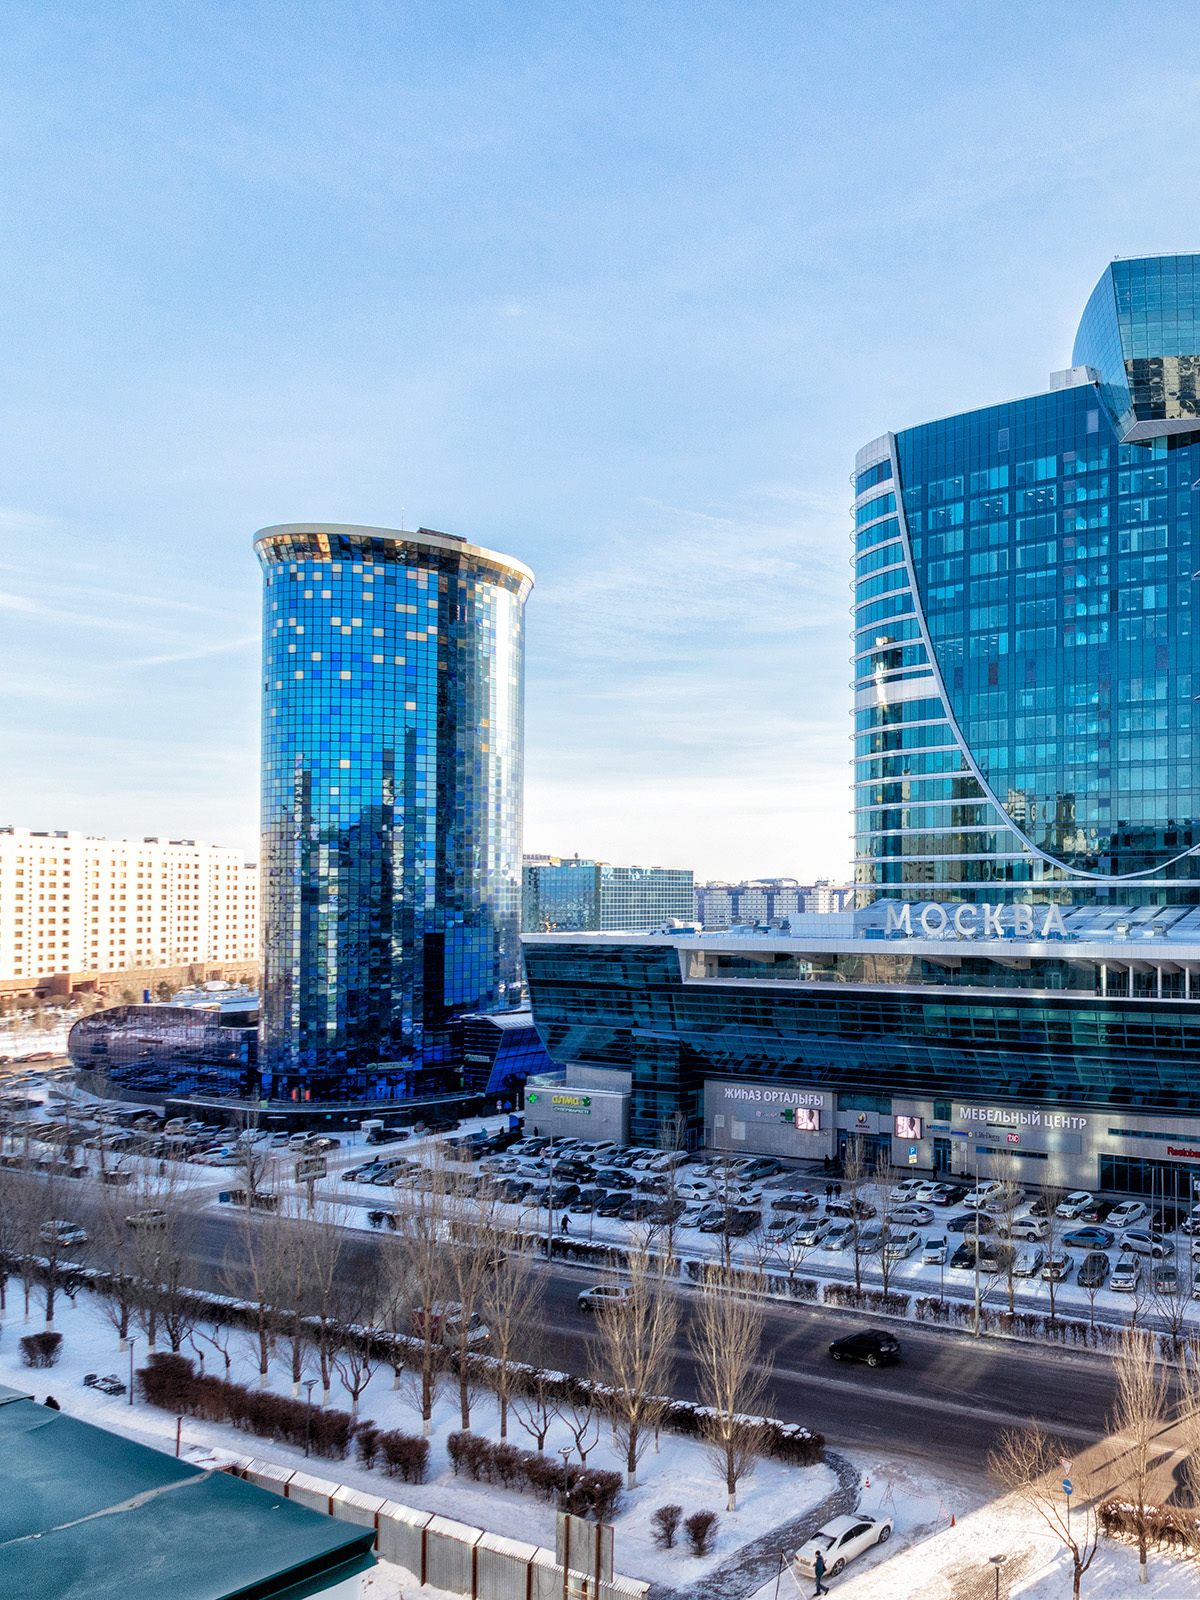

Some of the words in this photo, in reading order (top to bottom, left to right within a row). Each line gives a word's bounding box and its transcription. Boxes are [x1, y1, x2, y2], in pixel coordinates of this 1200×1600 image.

[884, 903, 1068, 936] МОСКВА
[763, 1091, 824, 1106] ОРТАЛЫҒЫ
[960, 1107, 1040, 1126] МЕБЕЛЬНЫЙ
[1044, 1114, 1087, 1130] ЦЕНТР
